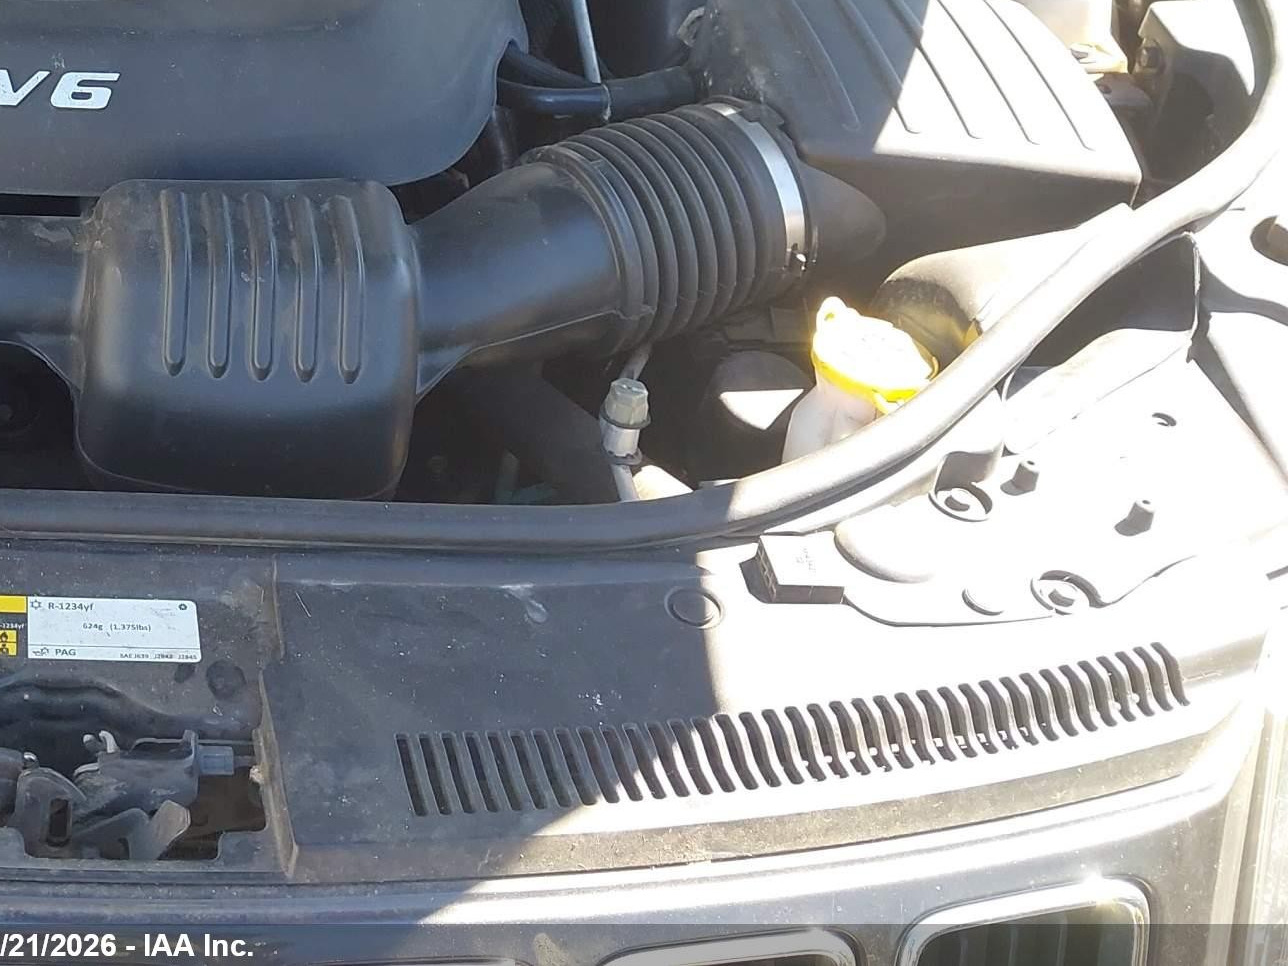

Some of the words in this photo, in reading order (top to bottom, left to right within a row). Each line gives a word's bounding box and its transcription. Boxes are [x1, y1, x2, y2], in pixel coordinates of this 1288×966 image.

[48, 602, 94, 613] R-1234yf
[83, 623, 103, 632] 624g
[55, 649, 77, 657] PAG
